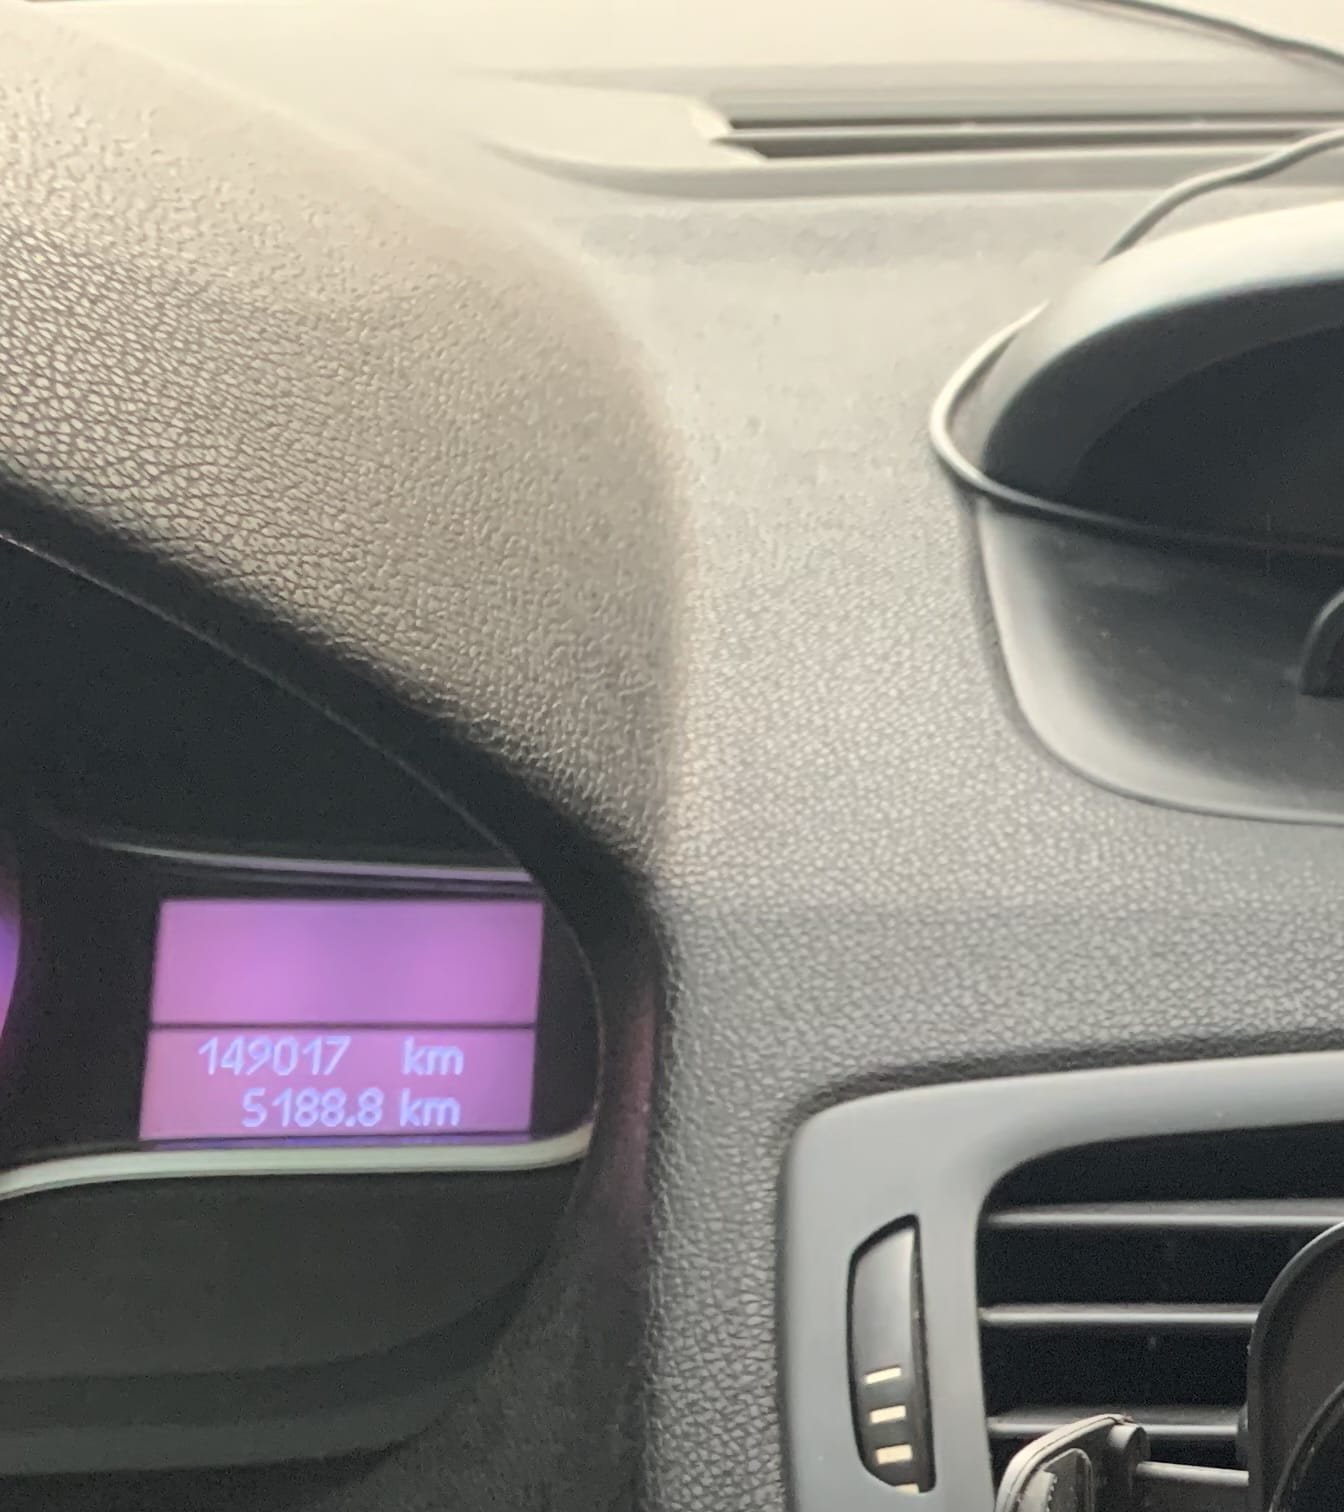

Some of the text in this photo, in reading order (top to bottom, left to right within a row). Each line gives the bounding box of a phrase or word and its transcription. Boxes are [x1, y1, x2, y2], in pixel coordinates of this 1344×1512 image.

[198, 1036, 464, 1076] 149017 km
[241, 1087, 461, 1128] 5188.8 km
